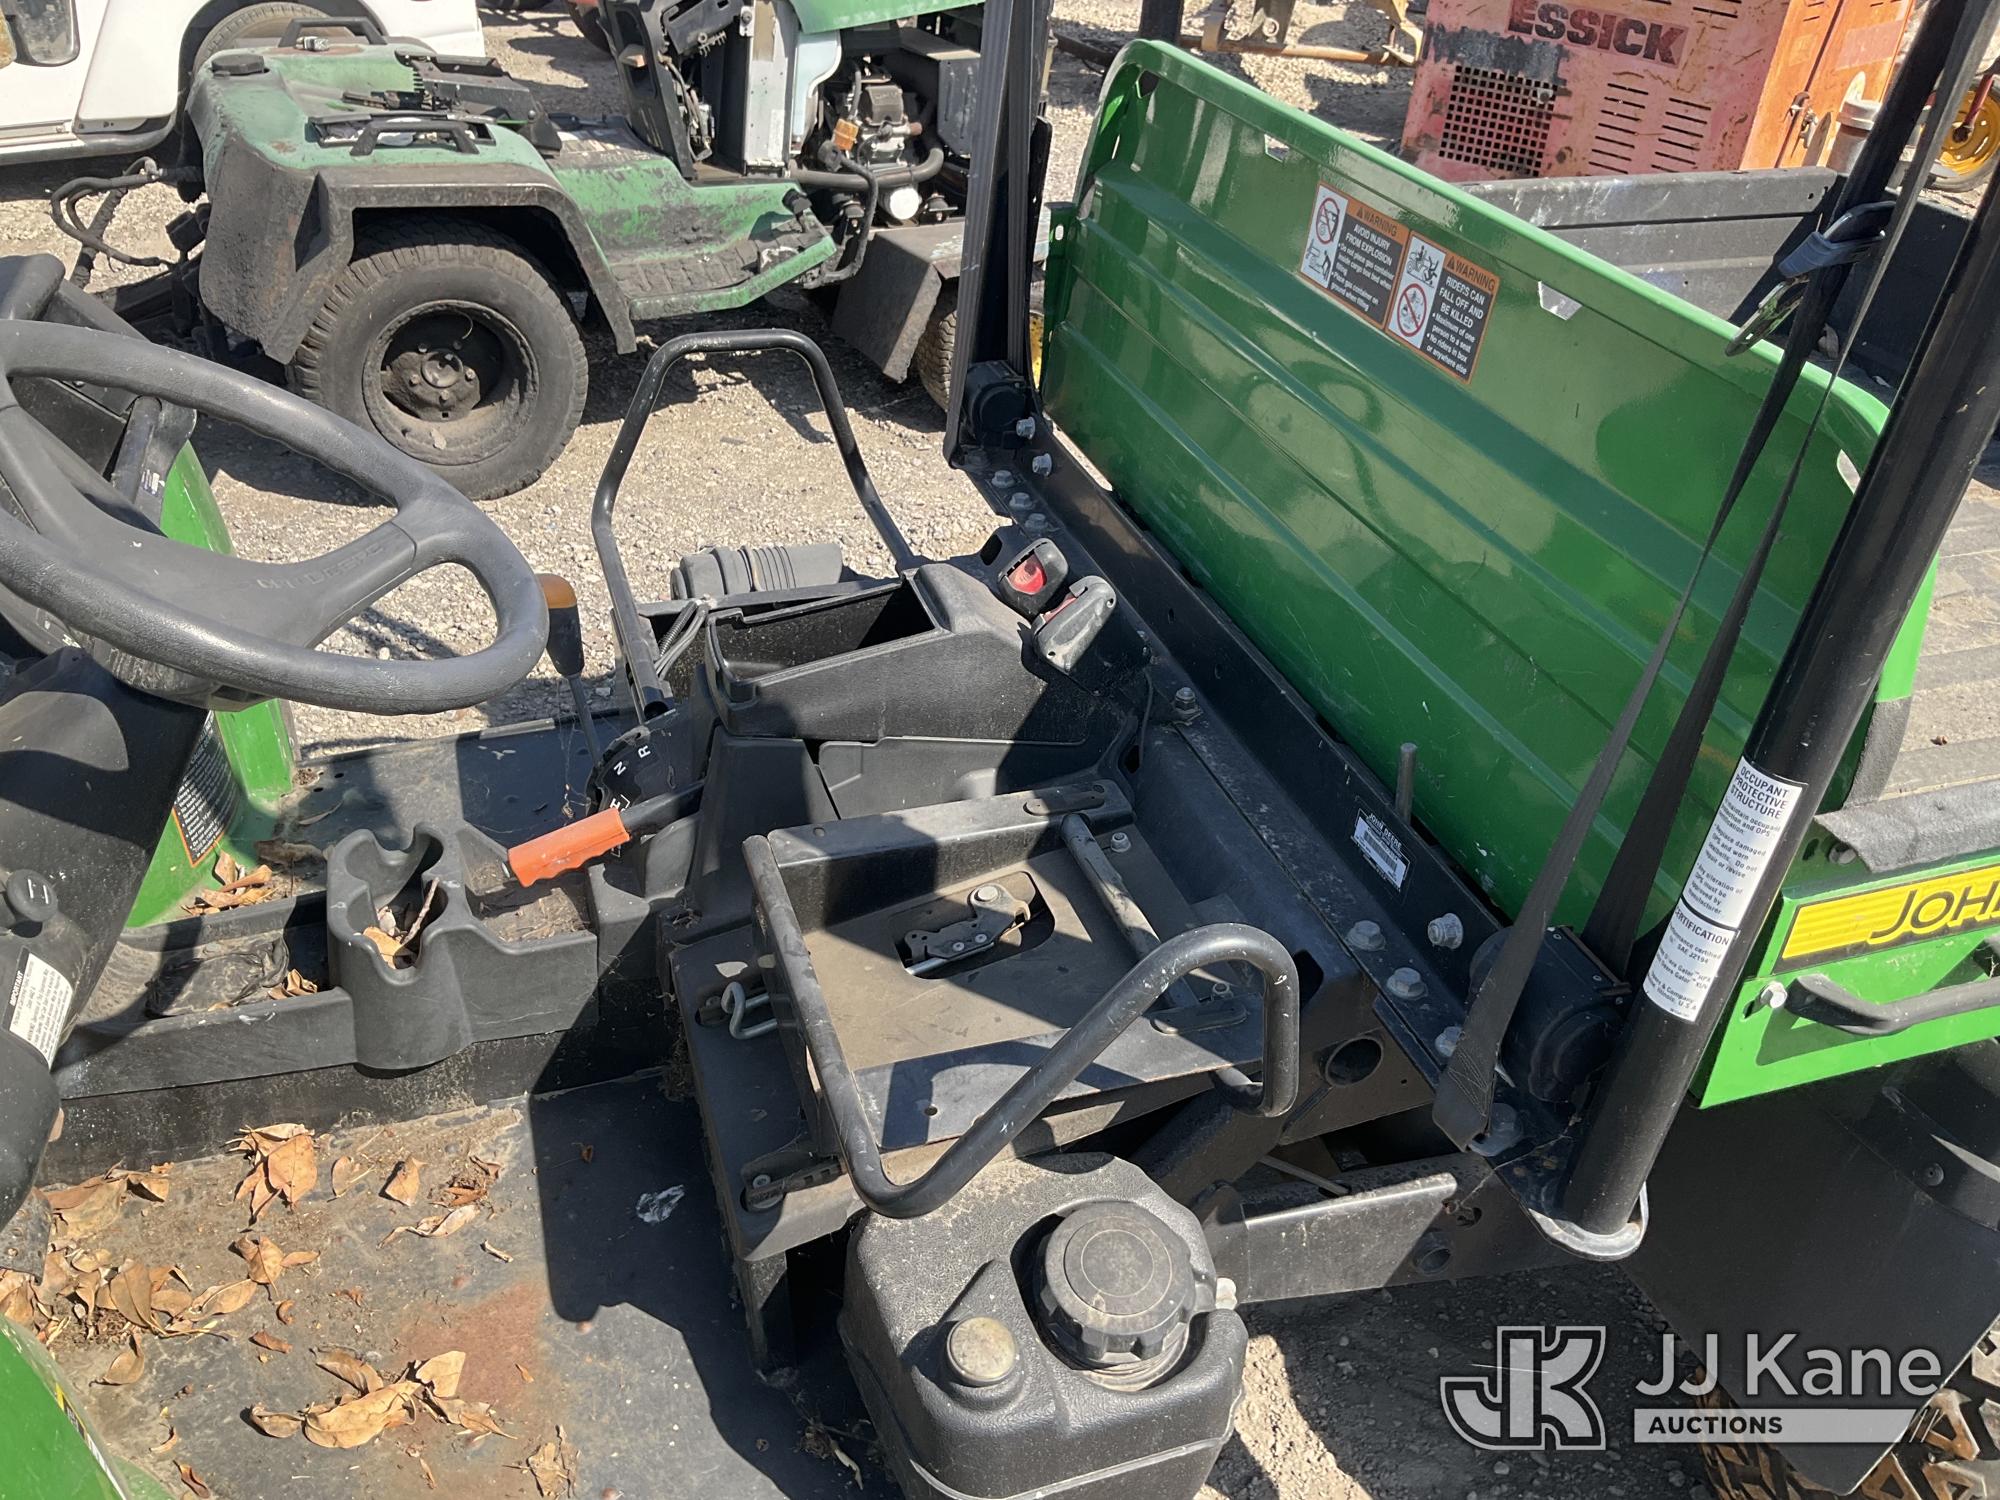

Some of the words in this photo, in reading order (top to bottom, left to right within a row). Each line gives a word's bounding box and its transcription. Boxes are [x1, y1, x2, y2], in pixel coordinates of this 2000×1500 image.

[1508, 0, 1685, 64] ESSICK
[1364, 209, 1397, 236] WARNING
[1345, 233, 1361, 248] FROM
[1361, 242, 1393, 266] EXPLOSION
[1354, 224, 1370, 239] AVOID
[1370, 233, 1390, 250] INJURY
[1456, 260, 1495, 291] WARNING
[1439, 288, 1454, 303] FALL
[1456, 297, 1470, 310] OFF
[1468, 305, 1483, 319] AND
[1446, 277, 1470, 296] RIDERS
[1470, 290, 1485, 305] CAN
[1435, 313, 1459, 333] Maximum
[1465, 333, 1475, 343] one
[1440, 302, 1450, 315] BE
[1450, 309, 1473, 328] KILLED
[1432, 325, 1450, 340] person
[1450, 334, 1455, 343] to
[1430, 334, 1437, 343] No
[1437, 340, 1451, 353] riders
[1451, 348, 1457, 357] in
[1457, 351, 1467, 363] box
[638, 745, 651, 758] R
[613, 761, 626, 776] N
[1741, 767, 1789, 798] OCCUPANT
[1731, 785, 1782, 819] STRUCTURE
[1735, 774, 1788, 809] PROTECTIVE
[1742, 822, 1756, 832] and
[1721, 842, 1731, 852] and
[1735, 841, 1766, 856] damaged
[1735, 860, 1744, 868] Do
[1870, 880, 2000, 939] JOH
[9, 970, 24, 1007] IMPORTANT
